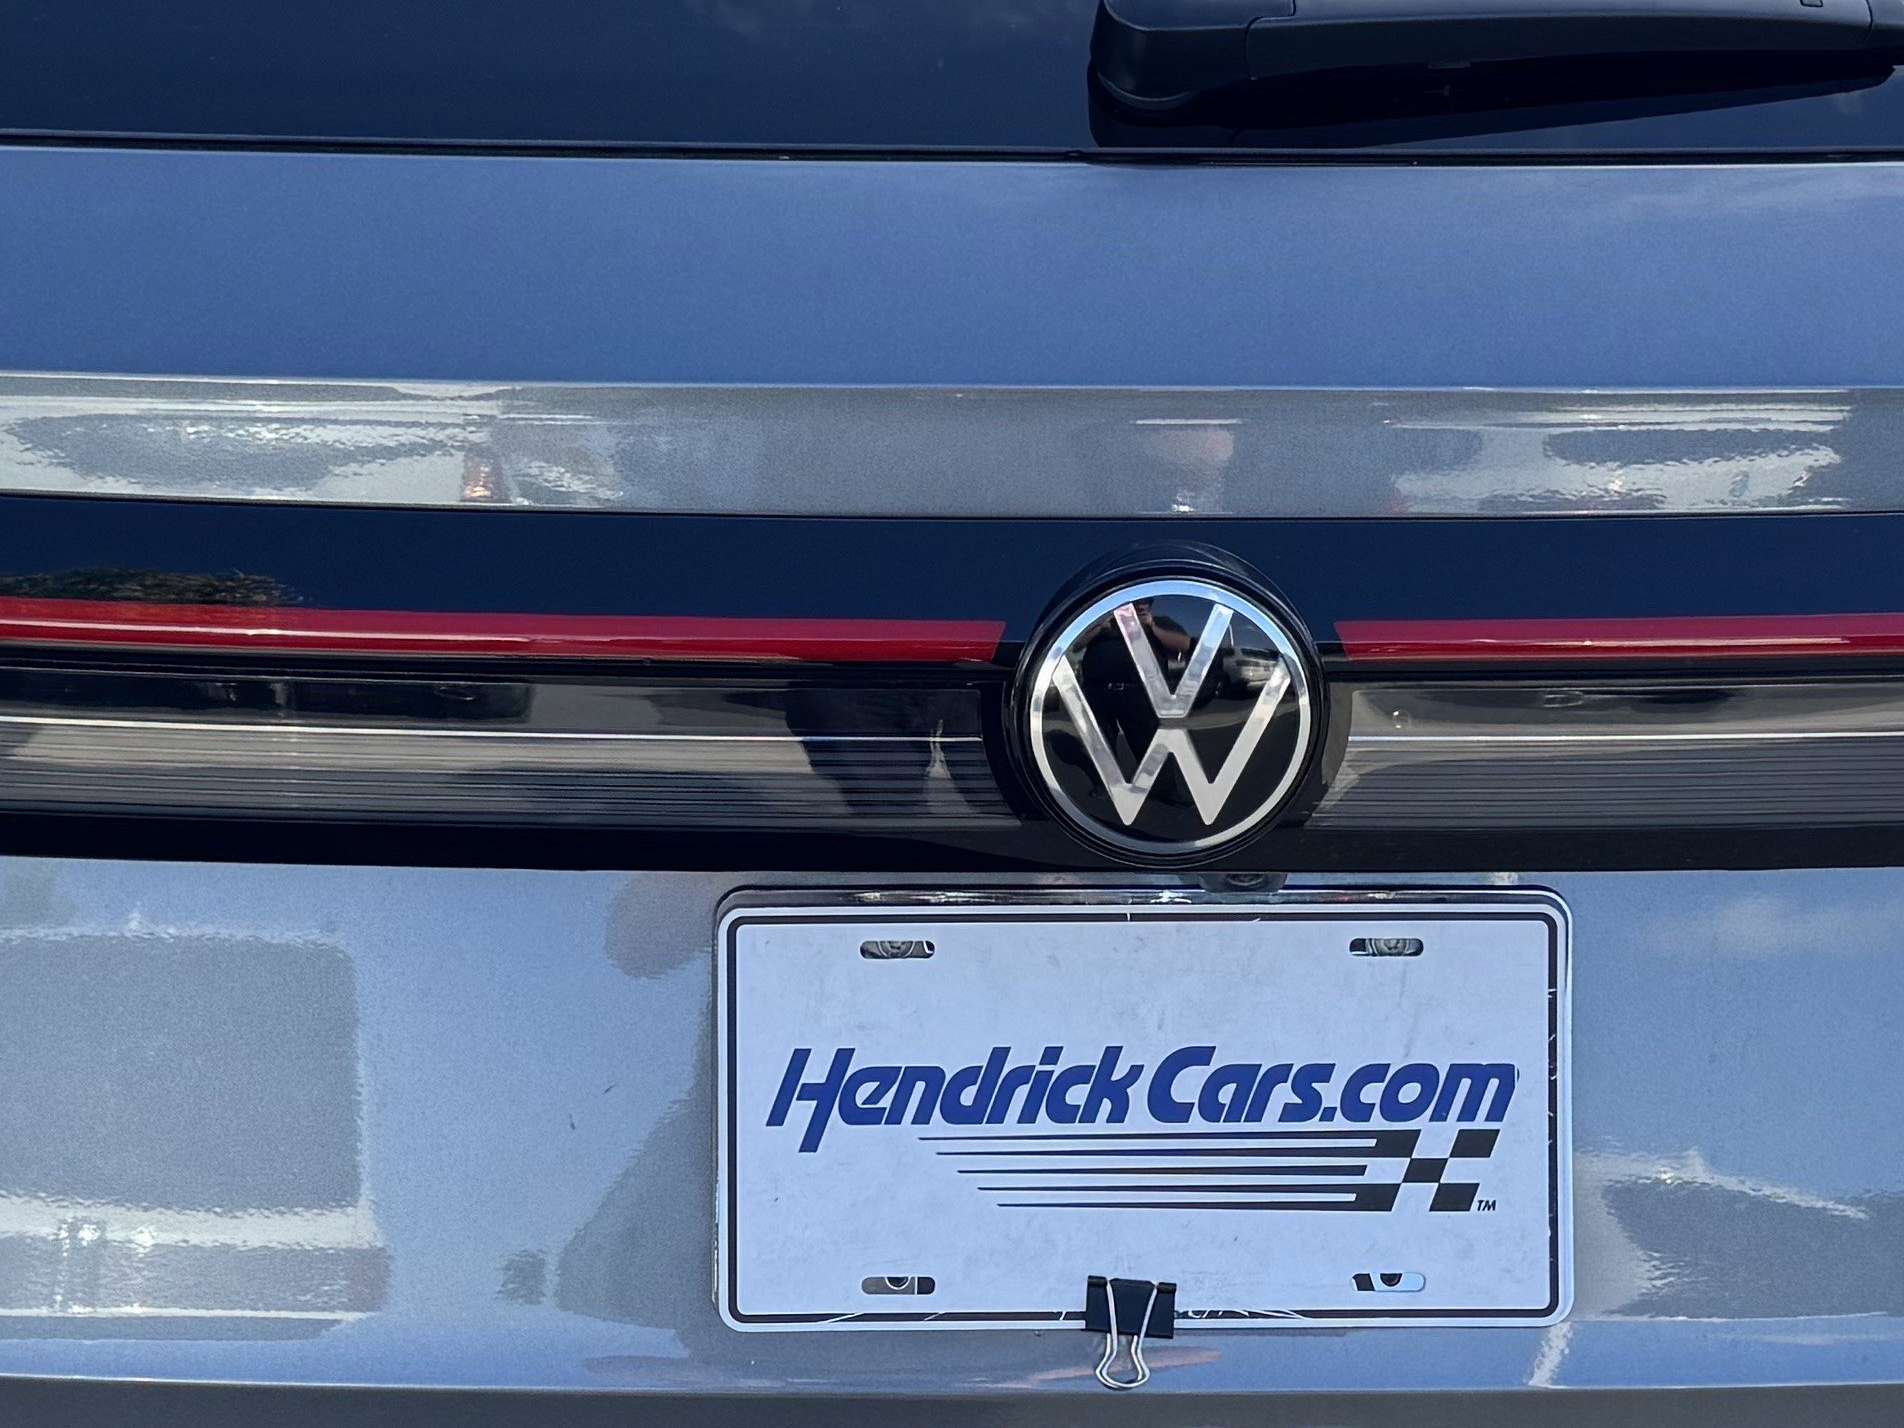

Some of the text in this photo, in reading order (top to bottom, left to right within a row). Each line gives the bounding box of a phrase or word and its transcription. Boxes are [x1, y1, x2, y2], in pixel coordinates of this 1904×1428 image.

[765, 1045, 1520, 1153] Hendrick Cars.com
[1477, 1199, 1497, 1212] TM
